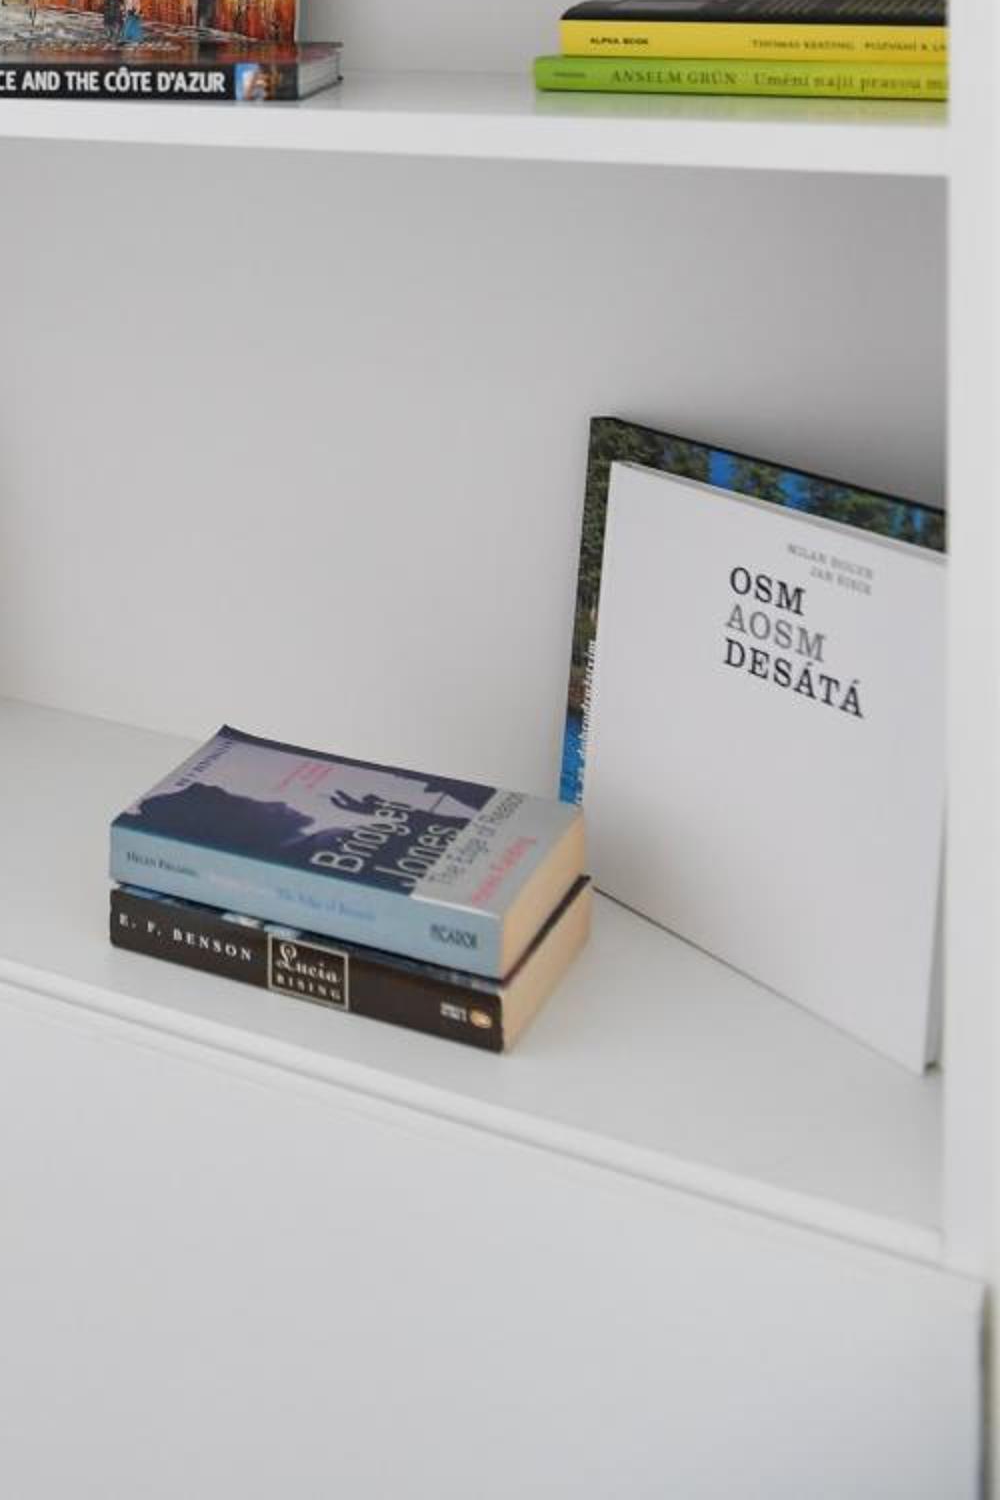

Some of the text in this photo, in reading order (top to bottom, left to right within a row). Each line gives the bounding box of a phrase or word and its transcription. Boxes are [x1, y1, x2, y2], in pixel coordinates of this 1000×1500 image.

[21, 71, 60, 91] AND
[65, 71, 99, 91] THE
[104, 66, 152, 92] CÔTE
[157, 71, 226, 93] D'AZUR
[610, 68, 683, 84] ANSELM
[730, 566, 806, 617] OSM
[725, 604, 827, 663] AOSM
[723, 636, 865, 719] DESÁTÁ
[309, 798, 412, 873] Bridget
[375, 823, 458, 888] Jones
[119, 913, 252, 961] E. F. BENSON
[276, 941, 340, 983] Lucia
[276, 973, 341, 1001] RISING
